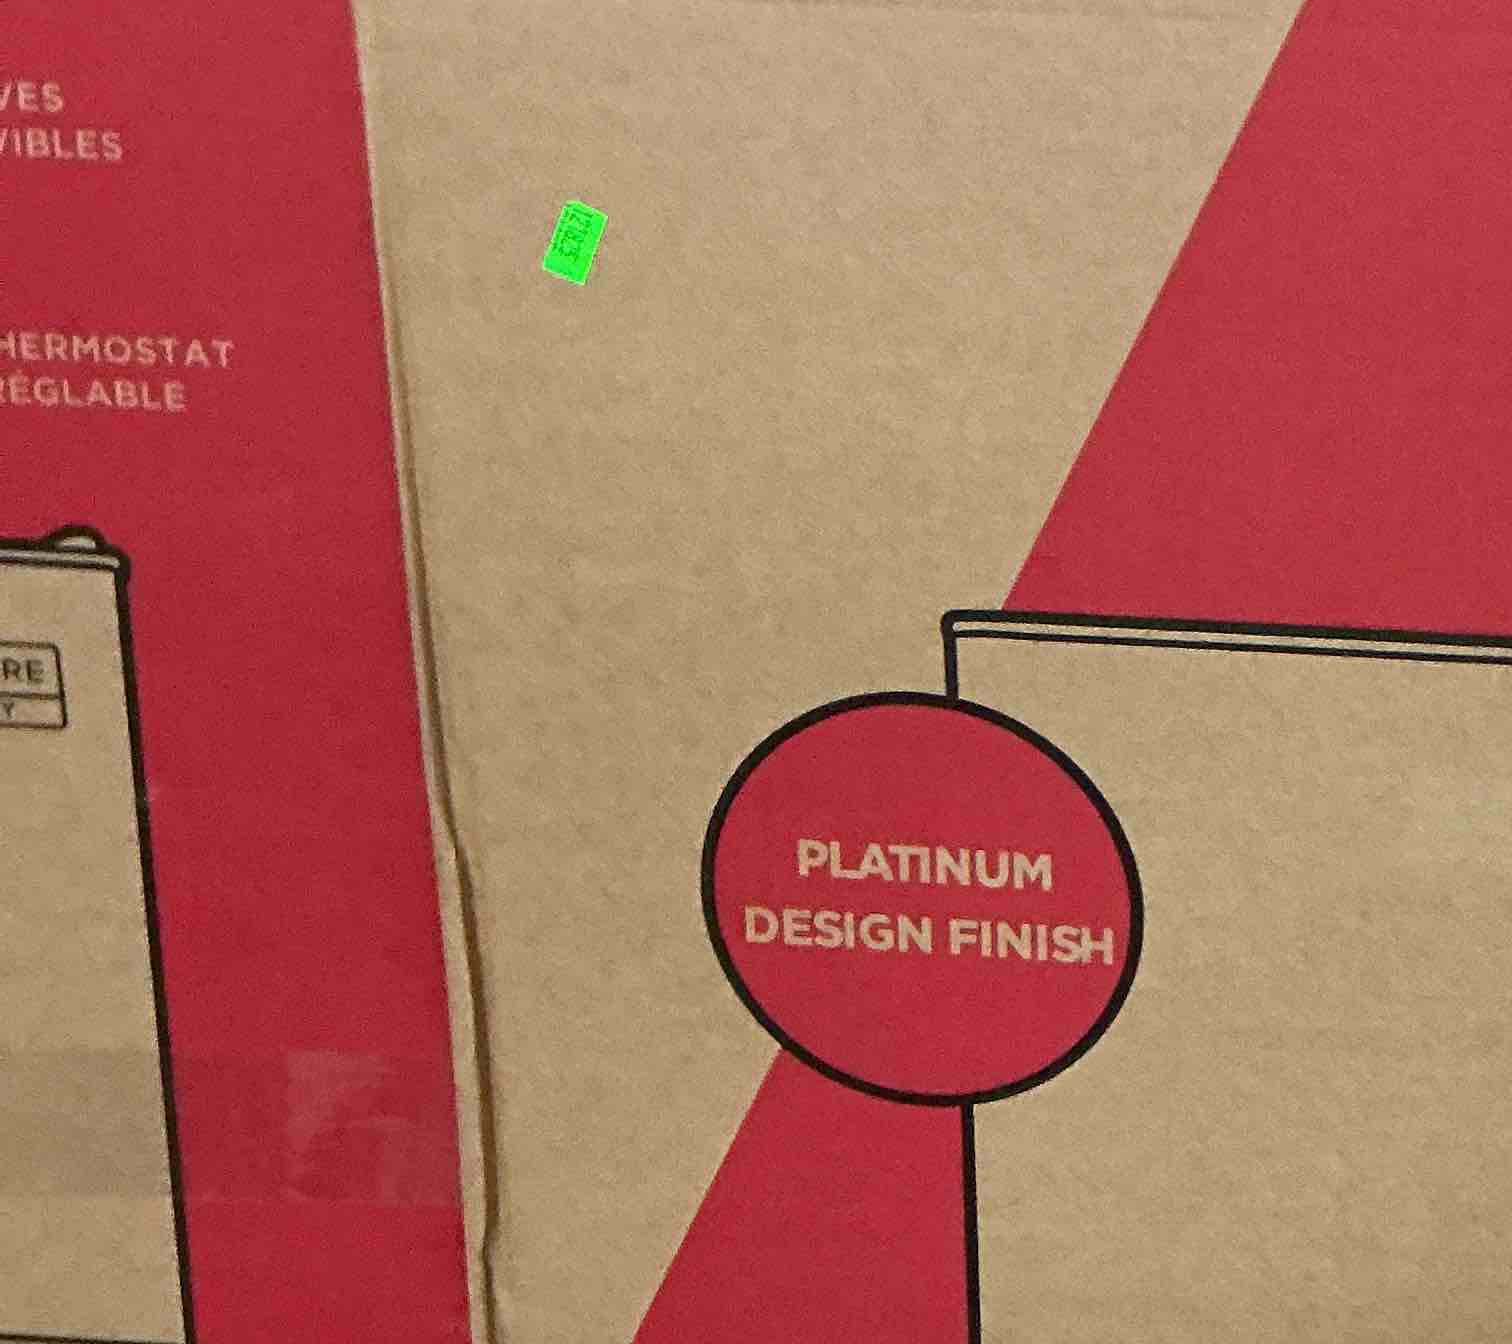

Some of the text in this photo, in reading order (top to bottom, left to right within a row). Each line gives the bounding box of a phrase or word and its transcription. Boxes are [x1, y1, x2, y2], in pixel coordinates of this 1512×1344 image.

[797, 838, 1053, 892] PLATINUM
[744, 906, 1114, 965] DESIGN FINISH
